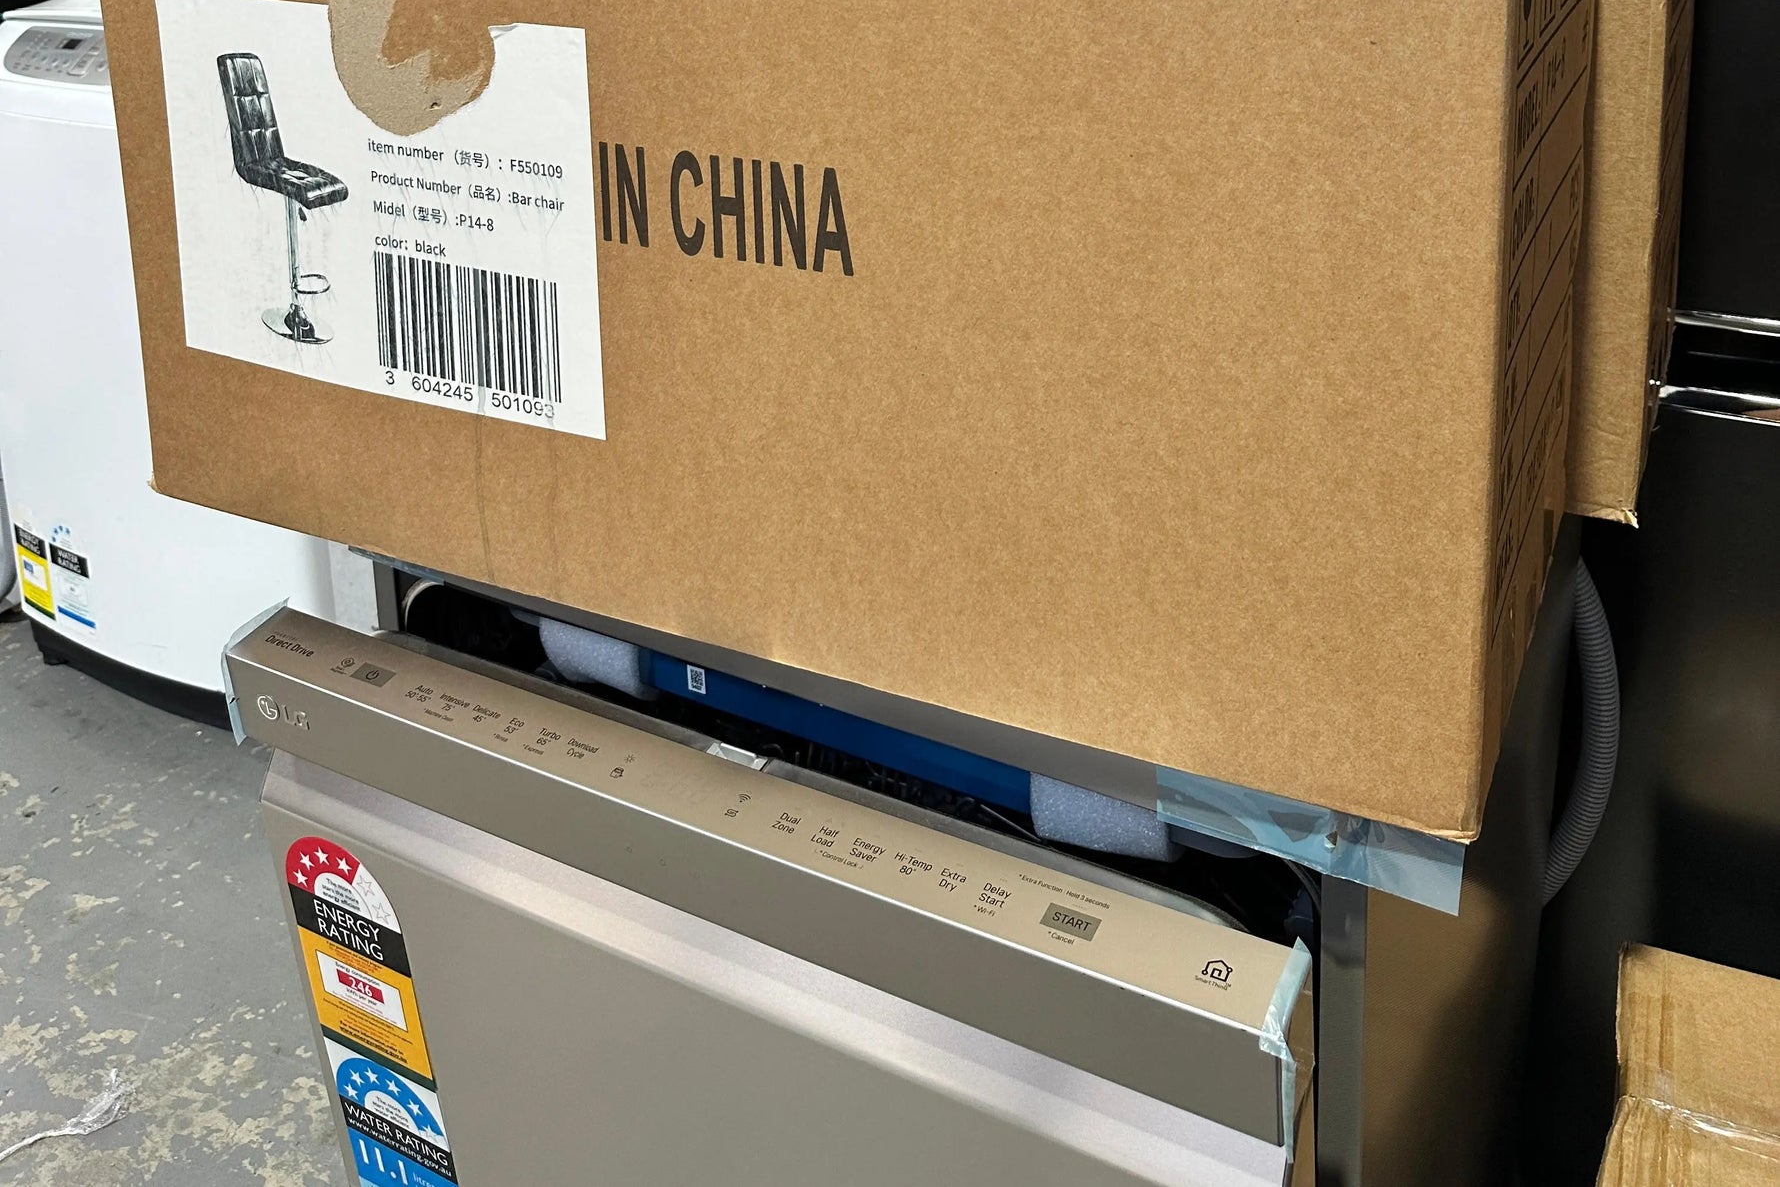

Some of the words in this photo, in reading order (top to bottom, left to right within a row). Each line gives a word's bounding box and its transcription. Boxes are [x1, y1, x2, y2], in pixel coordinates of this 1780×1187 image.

[368, 138, 394, 154] item
[397, 146, 444, 161] number
[510, 160, 563, 179] F550109
[371, 171, 414, 188] Product
[416, 177, 462, 195] Number
[534, 194, 565, 211] chair
[373, 200, 405, 217] Midel
[598, 142, 649, 248] IN
[670, 150, 854, 276] CHINA
[415, 240, 446, 257] black
[385, 370, 395, 385] 3
[412, 376, 474, 402] 604245
[492, 392, 555, 419] 501093
[265, 634, 290, 649] Direct
[290, 643, 314, 657] Drive
[415, 685, 434, 694] Auto
[440, 693, 470, 708] Intensive
[282, 705, 310, 730] LG
[473, 704, 501, 718] Delicate
[509, 717, 524, 727] Eco
[540, 728, 561, 740] Turbo
[566, 748, 584, 758] Cycle
[568, 738, 600, 753] Download
[779, 812, 802, 825] Dual
[771, 821, 795, 834] Zone
[819, 826, 840, 838] Half
[810, 835, 834, 848] Load
[853, 838, 886, 856] Energy
[849, 848, 877, 863] Saver
[894, 852, 933, 872] Hi-Temp
[940, 868, 967, 883] Extra
[938, 878, 958, 892] Dry
[983, 882, 1012, 899] Delay
[979, 893, 1005, 908] Start
[1038, 880, 1062, 893] Function
[1066, 890, 1080, 899] Hold
[1084, 897, 1110, 910] seconds
[314, 899, 379, 942] ENERGY
[1052, 911, 1092, 932] START
[318, 918, 384, 960] RATING
[348, 976, 373, 997] 246
[344, 1102, 393, 1136] WATER
[396, 1128, 448, 1166] RATING
[348, 1117, 452, 1177] www.waterrating.gov.au
[359, 1139, 408, 1185] 11.1
